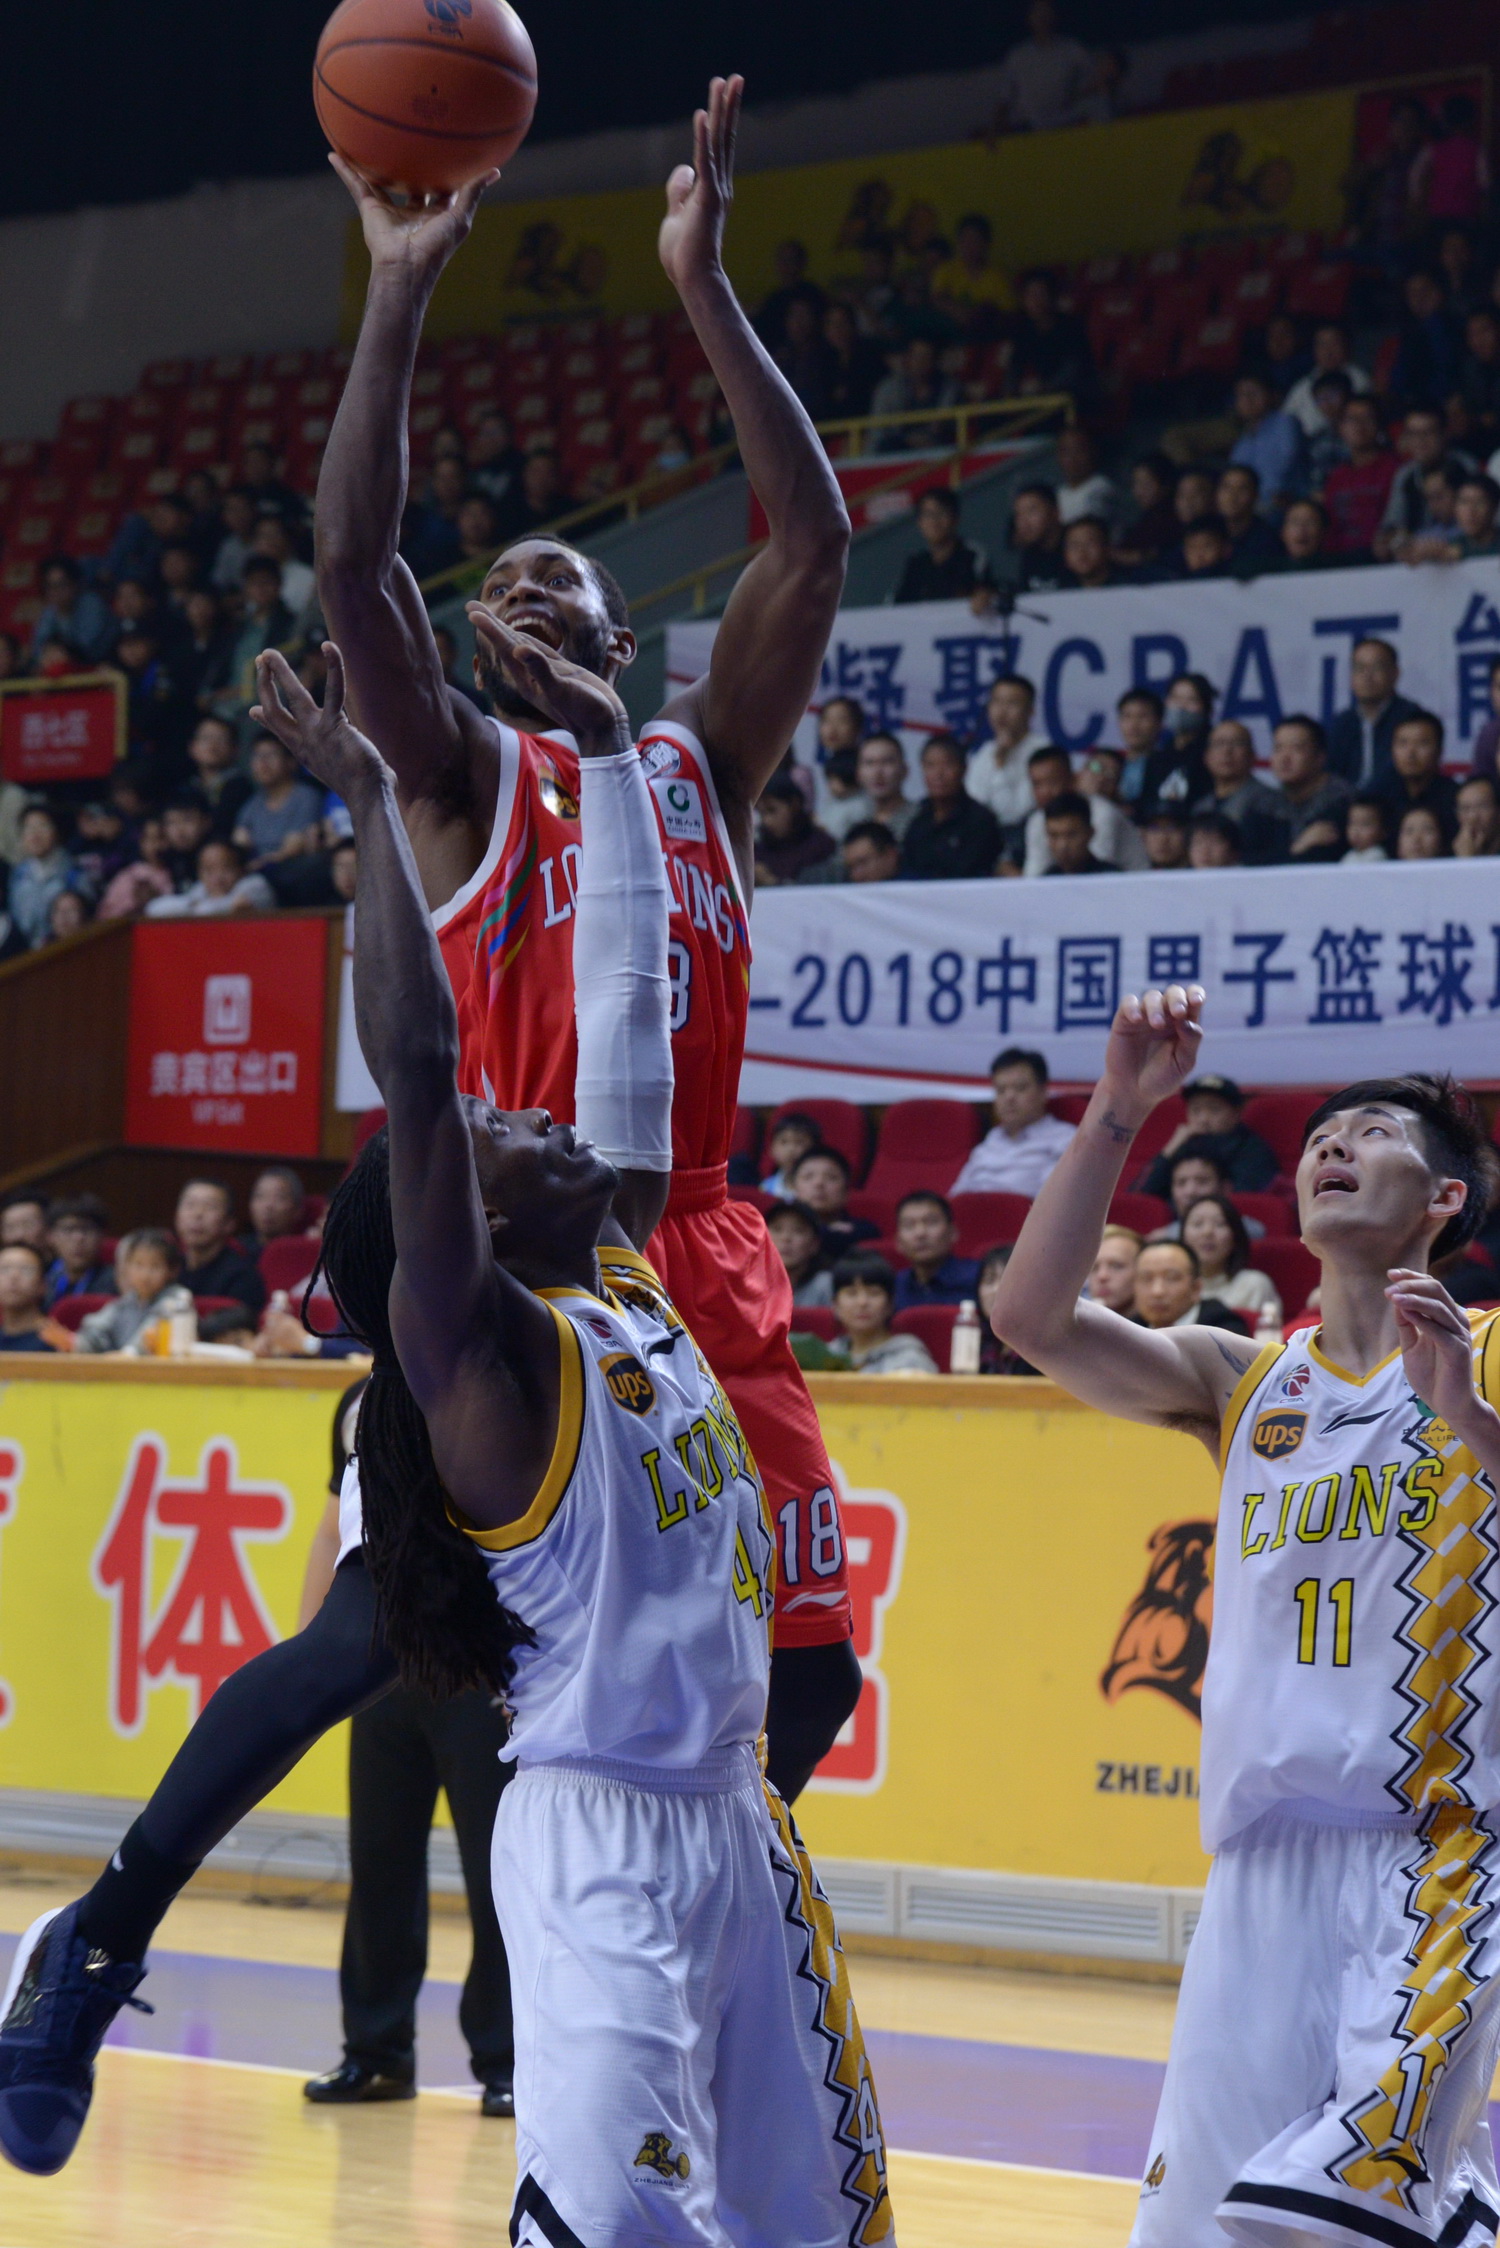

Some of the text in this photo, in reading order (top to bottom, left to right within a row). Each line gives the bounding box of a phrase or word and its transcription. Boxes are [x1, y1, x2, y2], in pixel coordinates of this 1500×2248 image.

[608, 1373, 652, 1407] ups
[641, 1396, 748, 1533] LION
[1256, 1424, 1301, 1453] ups
[778, 1485, 842, 1585] 18
[1241, 1457, 1443, 1563] LIONS
[1293, 1577, 1354, 1667] 11
[1096, 1763, 1200, 1800] ZHEJI
[857, 2077, 886, 2176] 4
